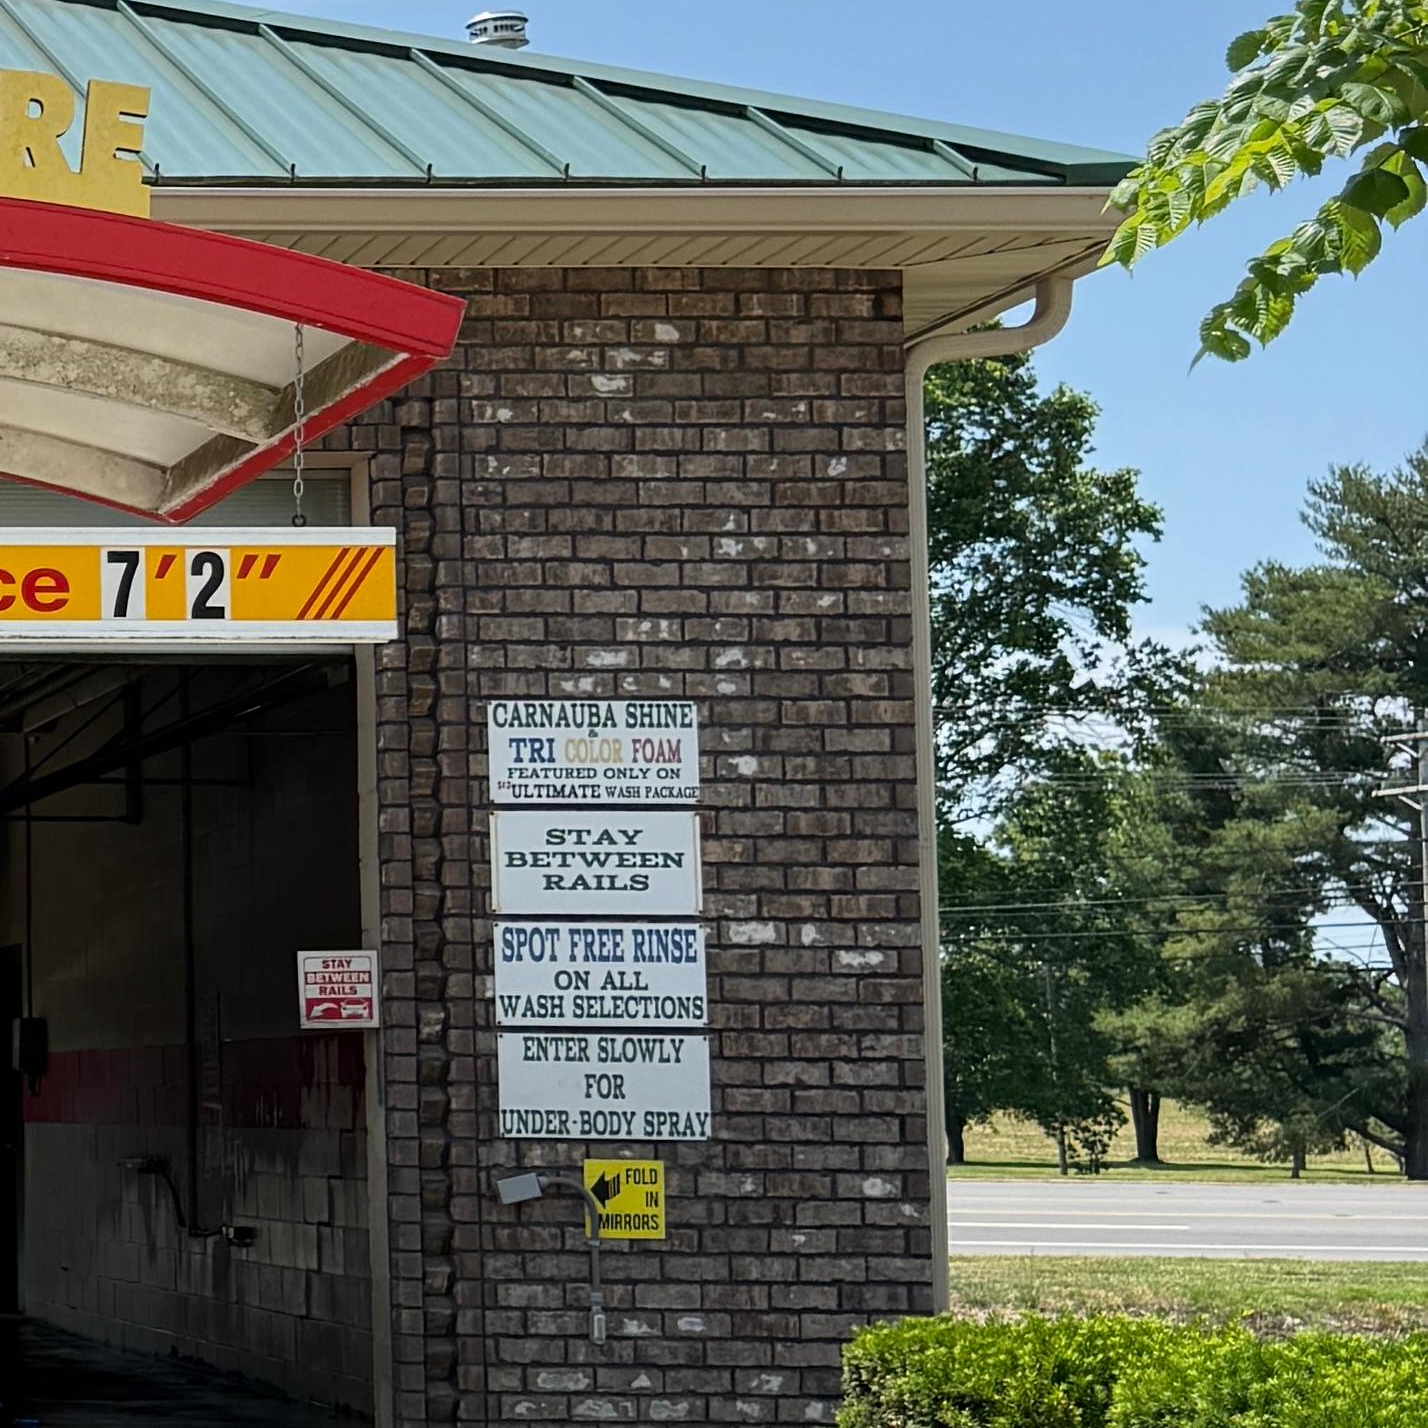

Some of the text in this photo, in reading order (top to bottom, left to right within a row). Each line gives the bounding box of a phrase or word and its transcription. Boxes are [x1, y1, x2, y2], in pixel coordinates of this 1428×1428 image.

[494, 703, 692, 728] CARNAUBA SHINE
[509, 738, 682, 764] TRI COLOR FOAM
[508, 768, 680, 779] FEATURED ONLY ON
[512, 785, 600, 798] ULTIMATE
[605, 786, 640, 798] WASH
[645, 786, 699, 798] PACKAGE
[545, 829, 643, 846] STAY
[505, 852, 684, 868] BETWEEN
[543, 874, 649, 891] RAILS
[501, 928, 697, 963] SPOT FREE RINSE
[322, 959, 351, 968] STAY
[307, 973, 369, 983] BETWEEN
[554, 971, 648, 991] ON ALL
[319, 986, 357, 995] RAILS
[499, 995, 704, 1020] WASH SELECTIONS
[522, 1037, 684, 1064] ENTER SLOWLY
[584, 1074, 625, 1098] FOR
[502, 1111, 709, 1137] UNDER-BODY SPRAY
[626, 1168, 657, 1184] FOLD
[646, 1192, 658, 1207] IN
[598, 1214, 658, 1230] MIRRORS
